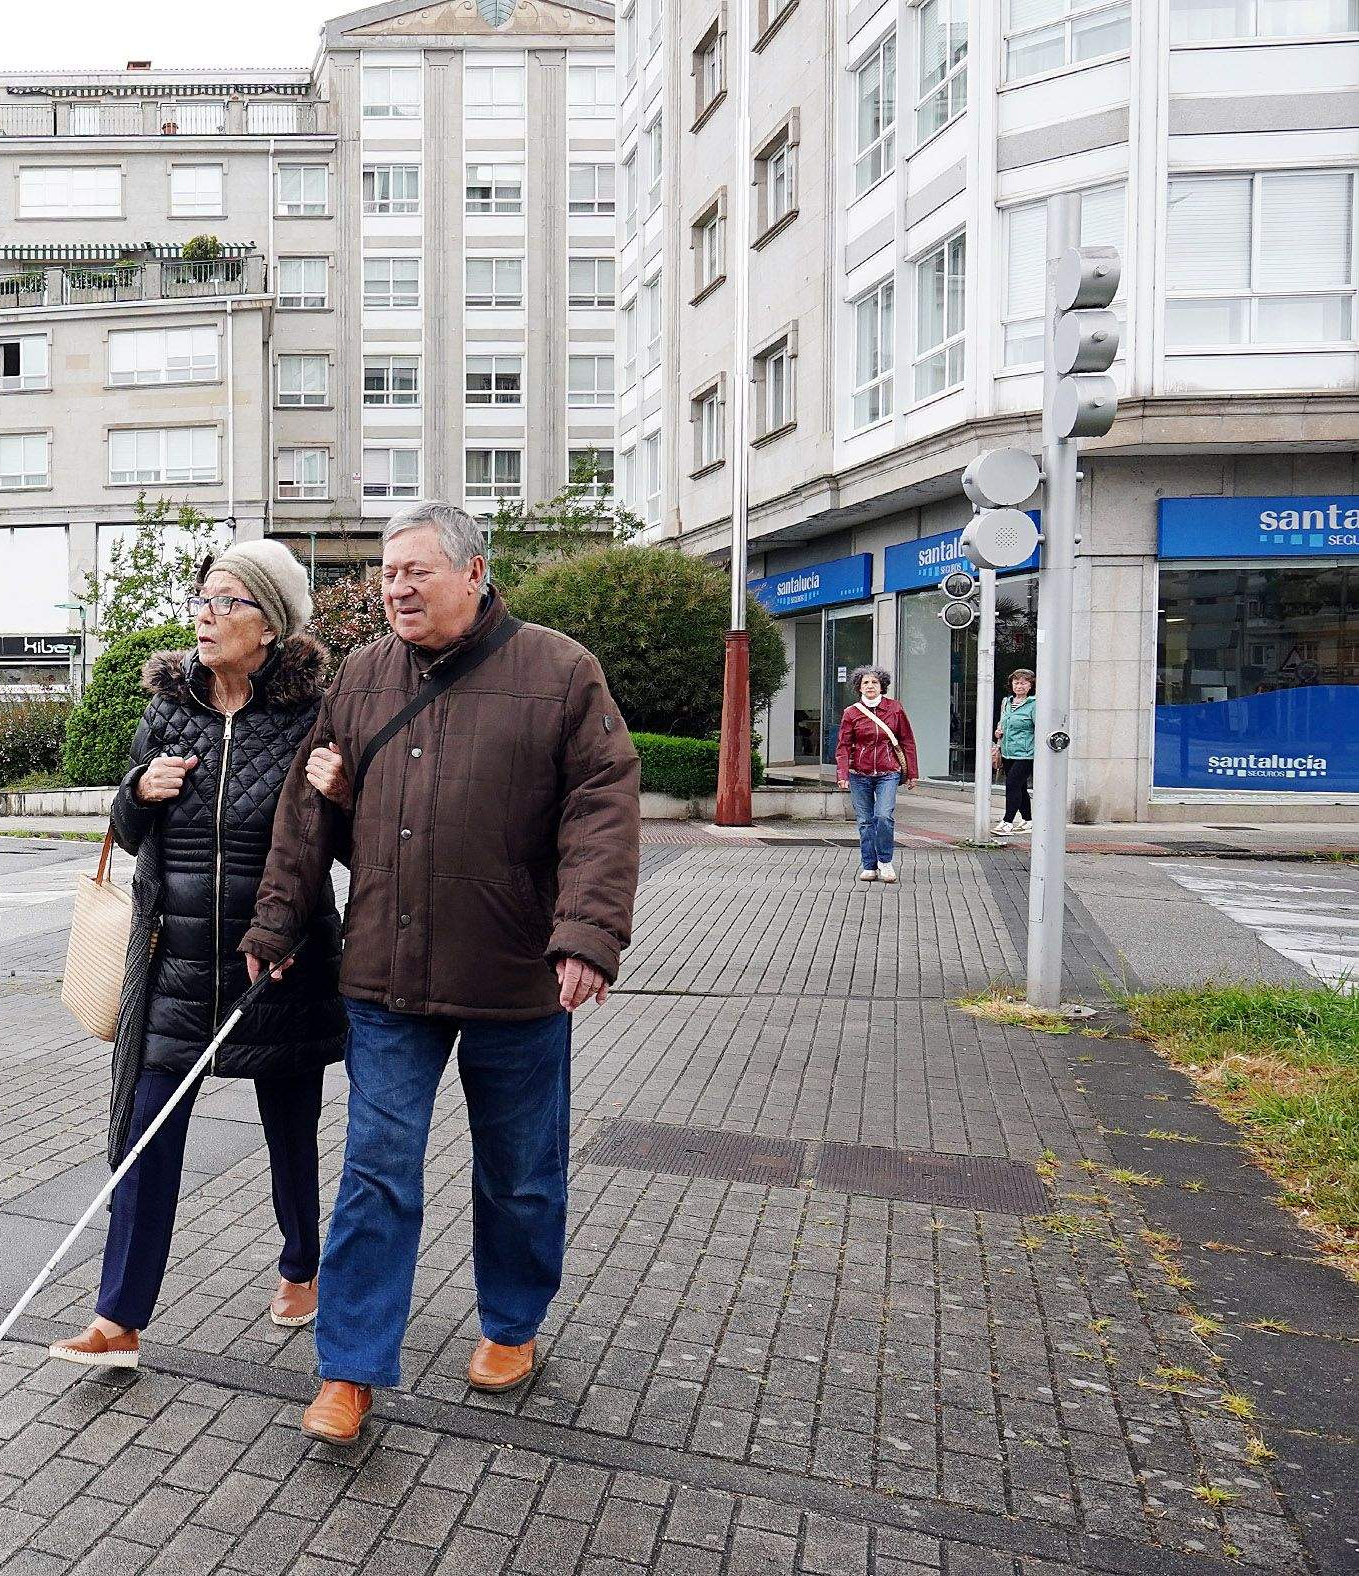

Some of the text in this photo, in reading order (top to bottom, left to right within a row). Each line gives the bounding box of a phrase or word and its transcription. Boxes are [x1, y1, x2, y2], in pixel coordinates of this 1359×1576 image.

[919, 537, 967, 566] santalu
[777, 571, 820, 596] santalucía
[1208, 755, 1327, 770] santalucía
